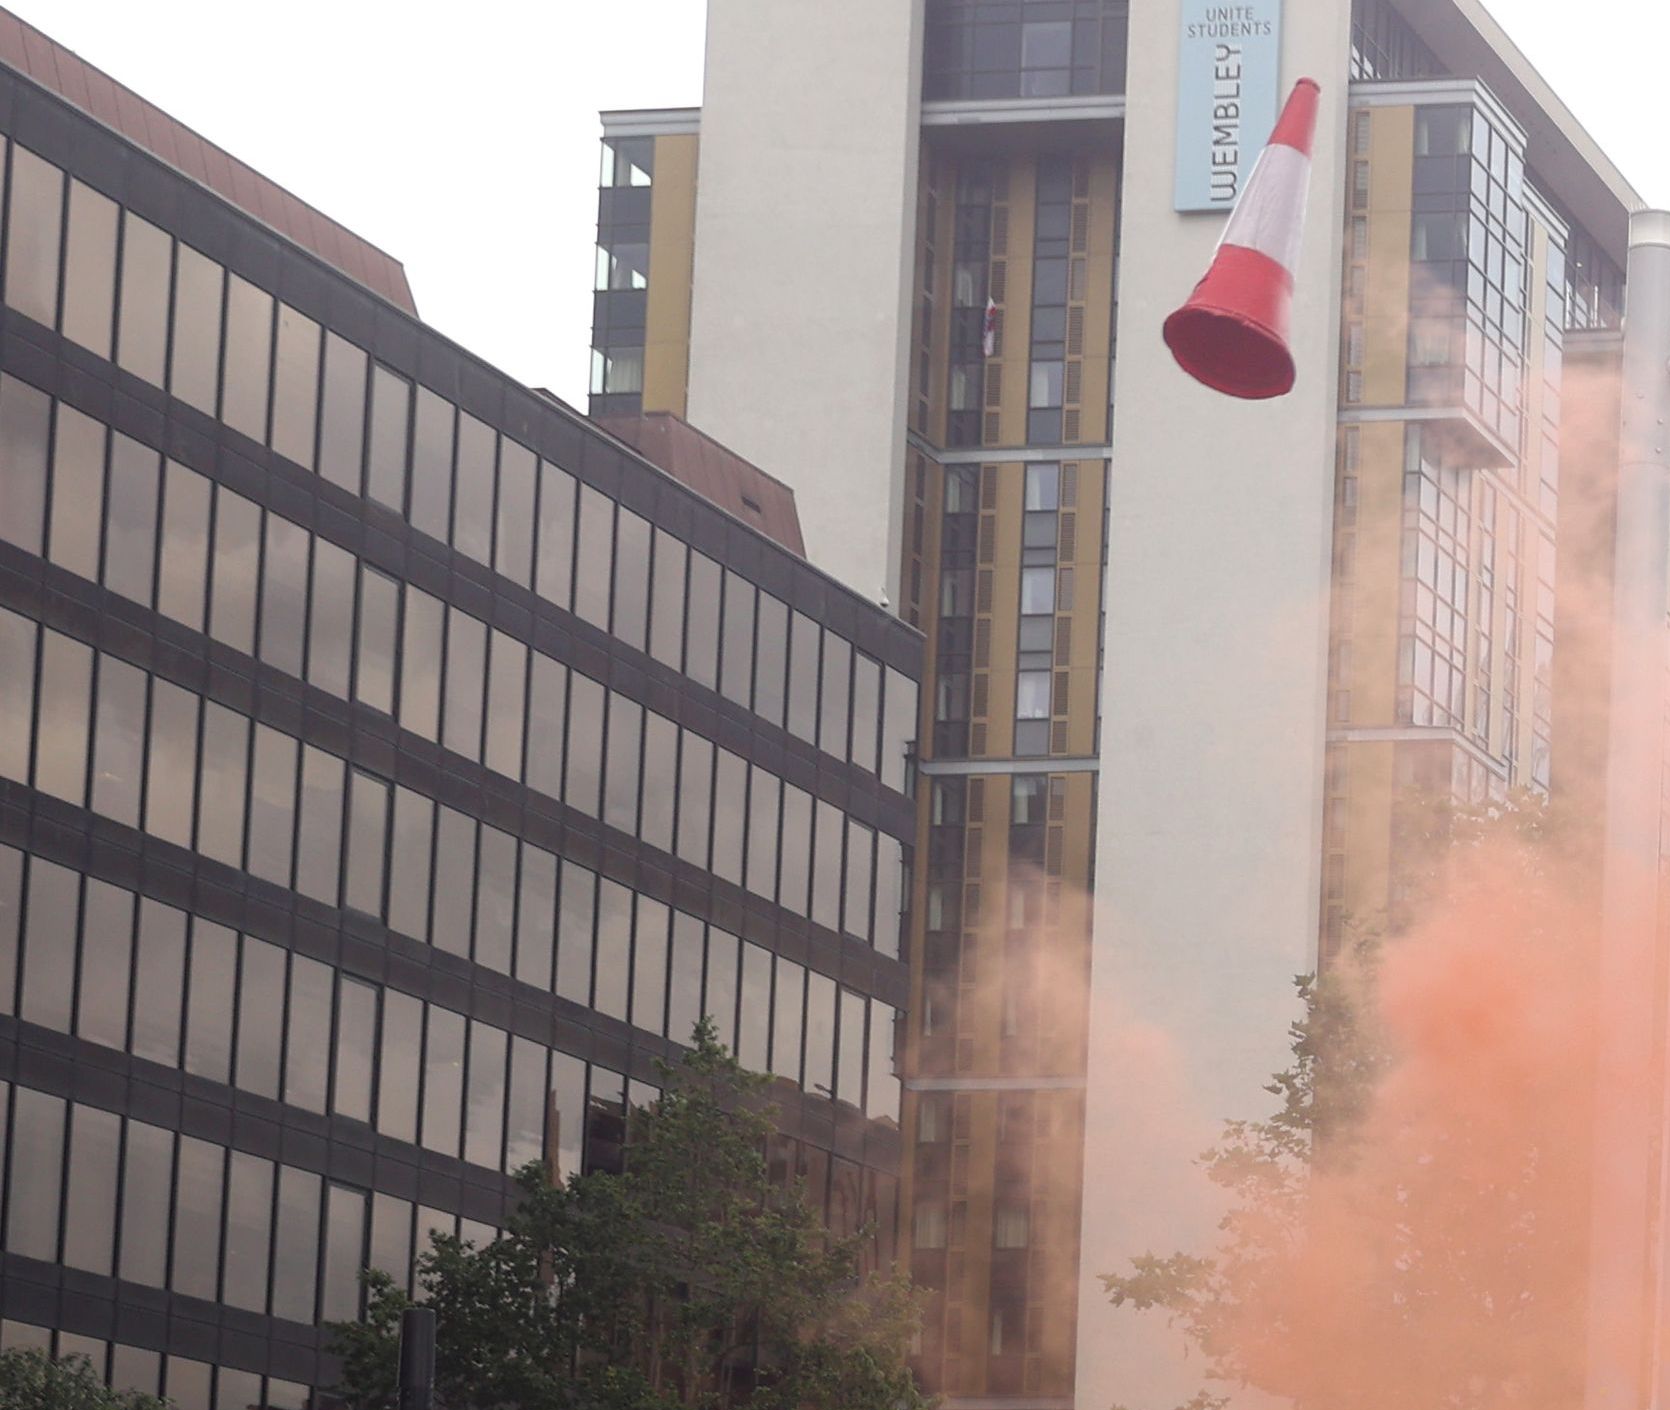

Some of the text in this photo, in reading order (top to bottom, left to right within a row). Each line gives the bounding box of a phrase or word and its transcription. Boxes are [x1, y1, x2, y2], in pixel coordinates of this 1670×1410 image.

[1206, 7, 1254, 22] UNITE
[1188, 22, 1272, 38] STUDENTS
[1210, 44, 1242, 202] WEMBLEY
